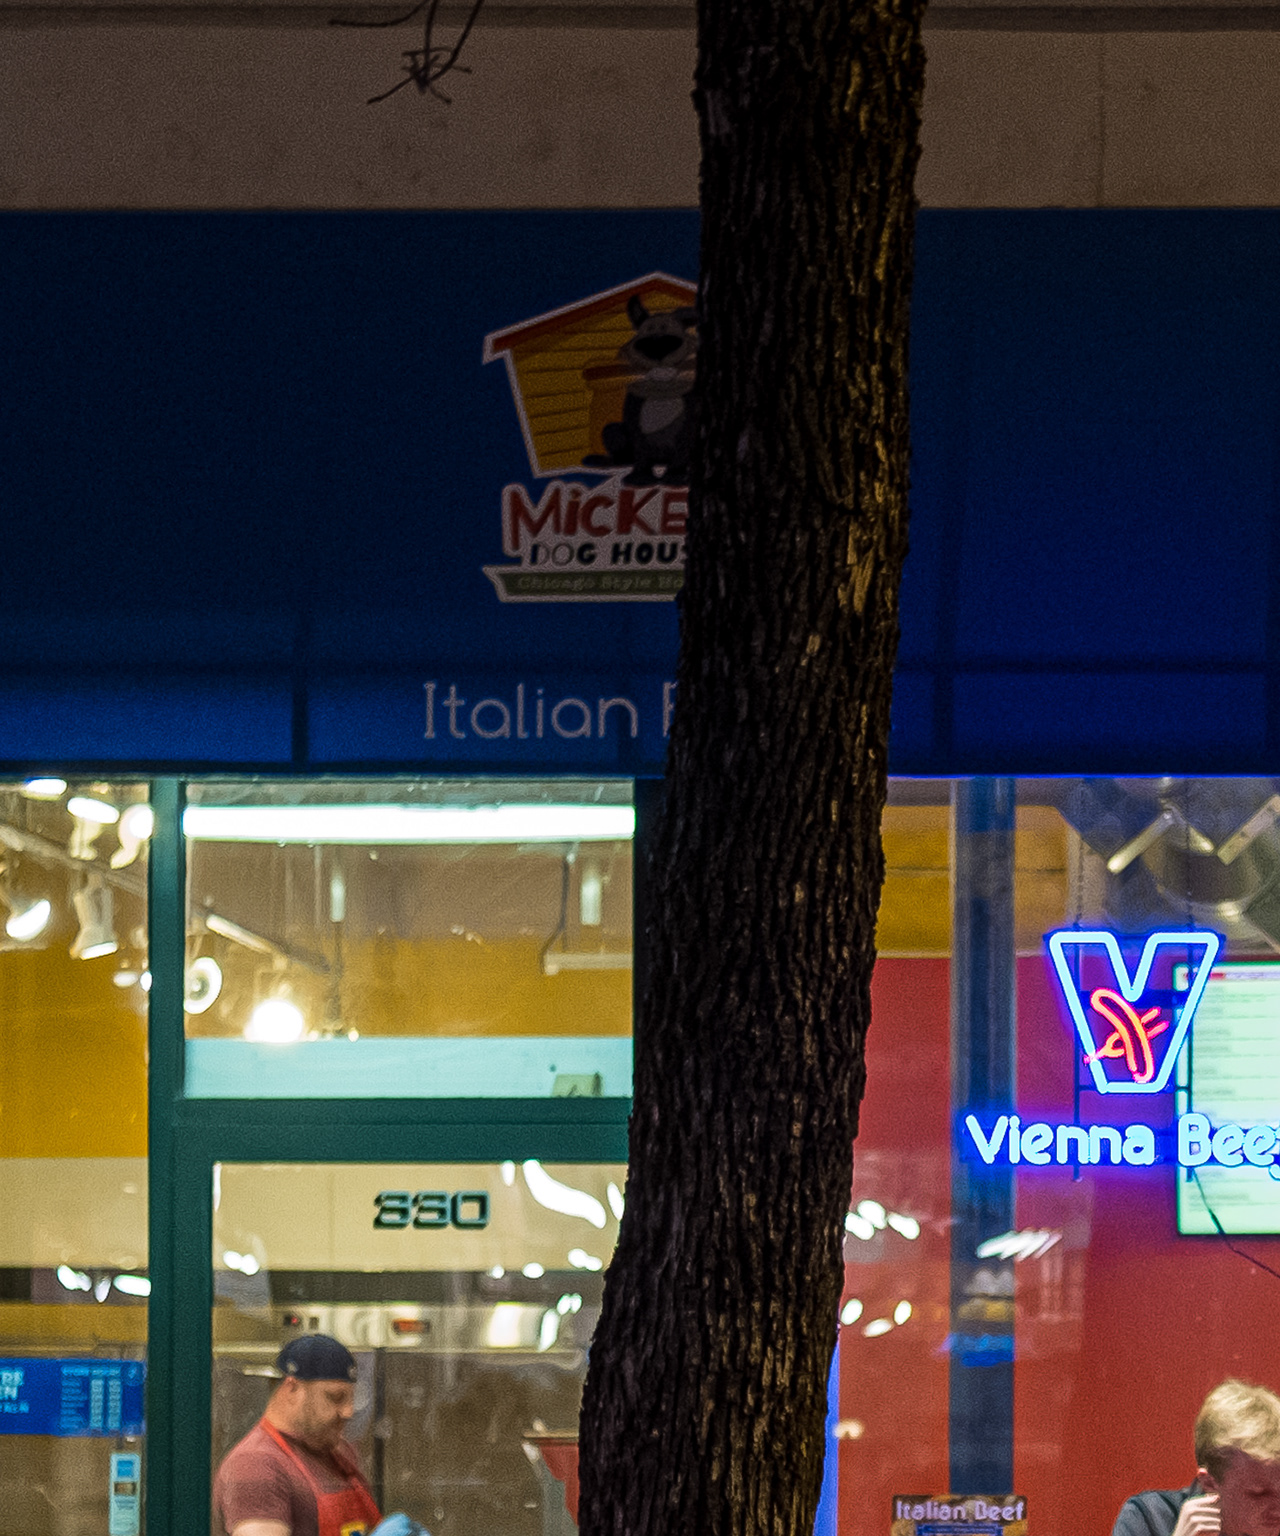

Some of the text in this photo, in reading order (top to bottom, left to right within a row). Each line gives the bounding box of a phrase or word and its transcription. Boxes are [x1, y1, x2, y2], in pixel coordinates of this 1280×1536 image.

[611, 543, 687, 565] HOU
[423, 681, 639, 740] Italian
[965, 1114, 1156, 1166] Vienna
[897, 1500, 1025, 1521] Italian Beef
